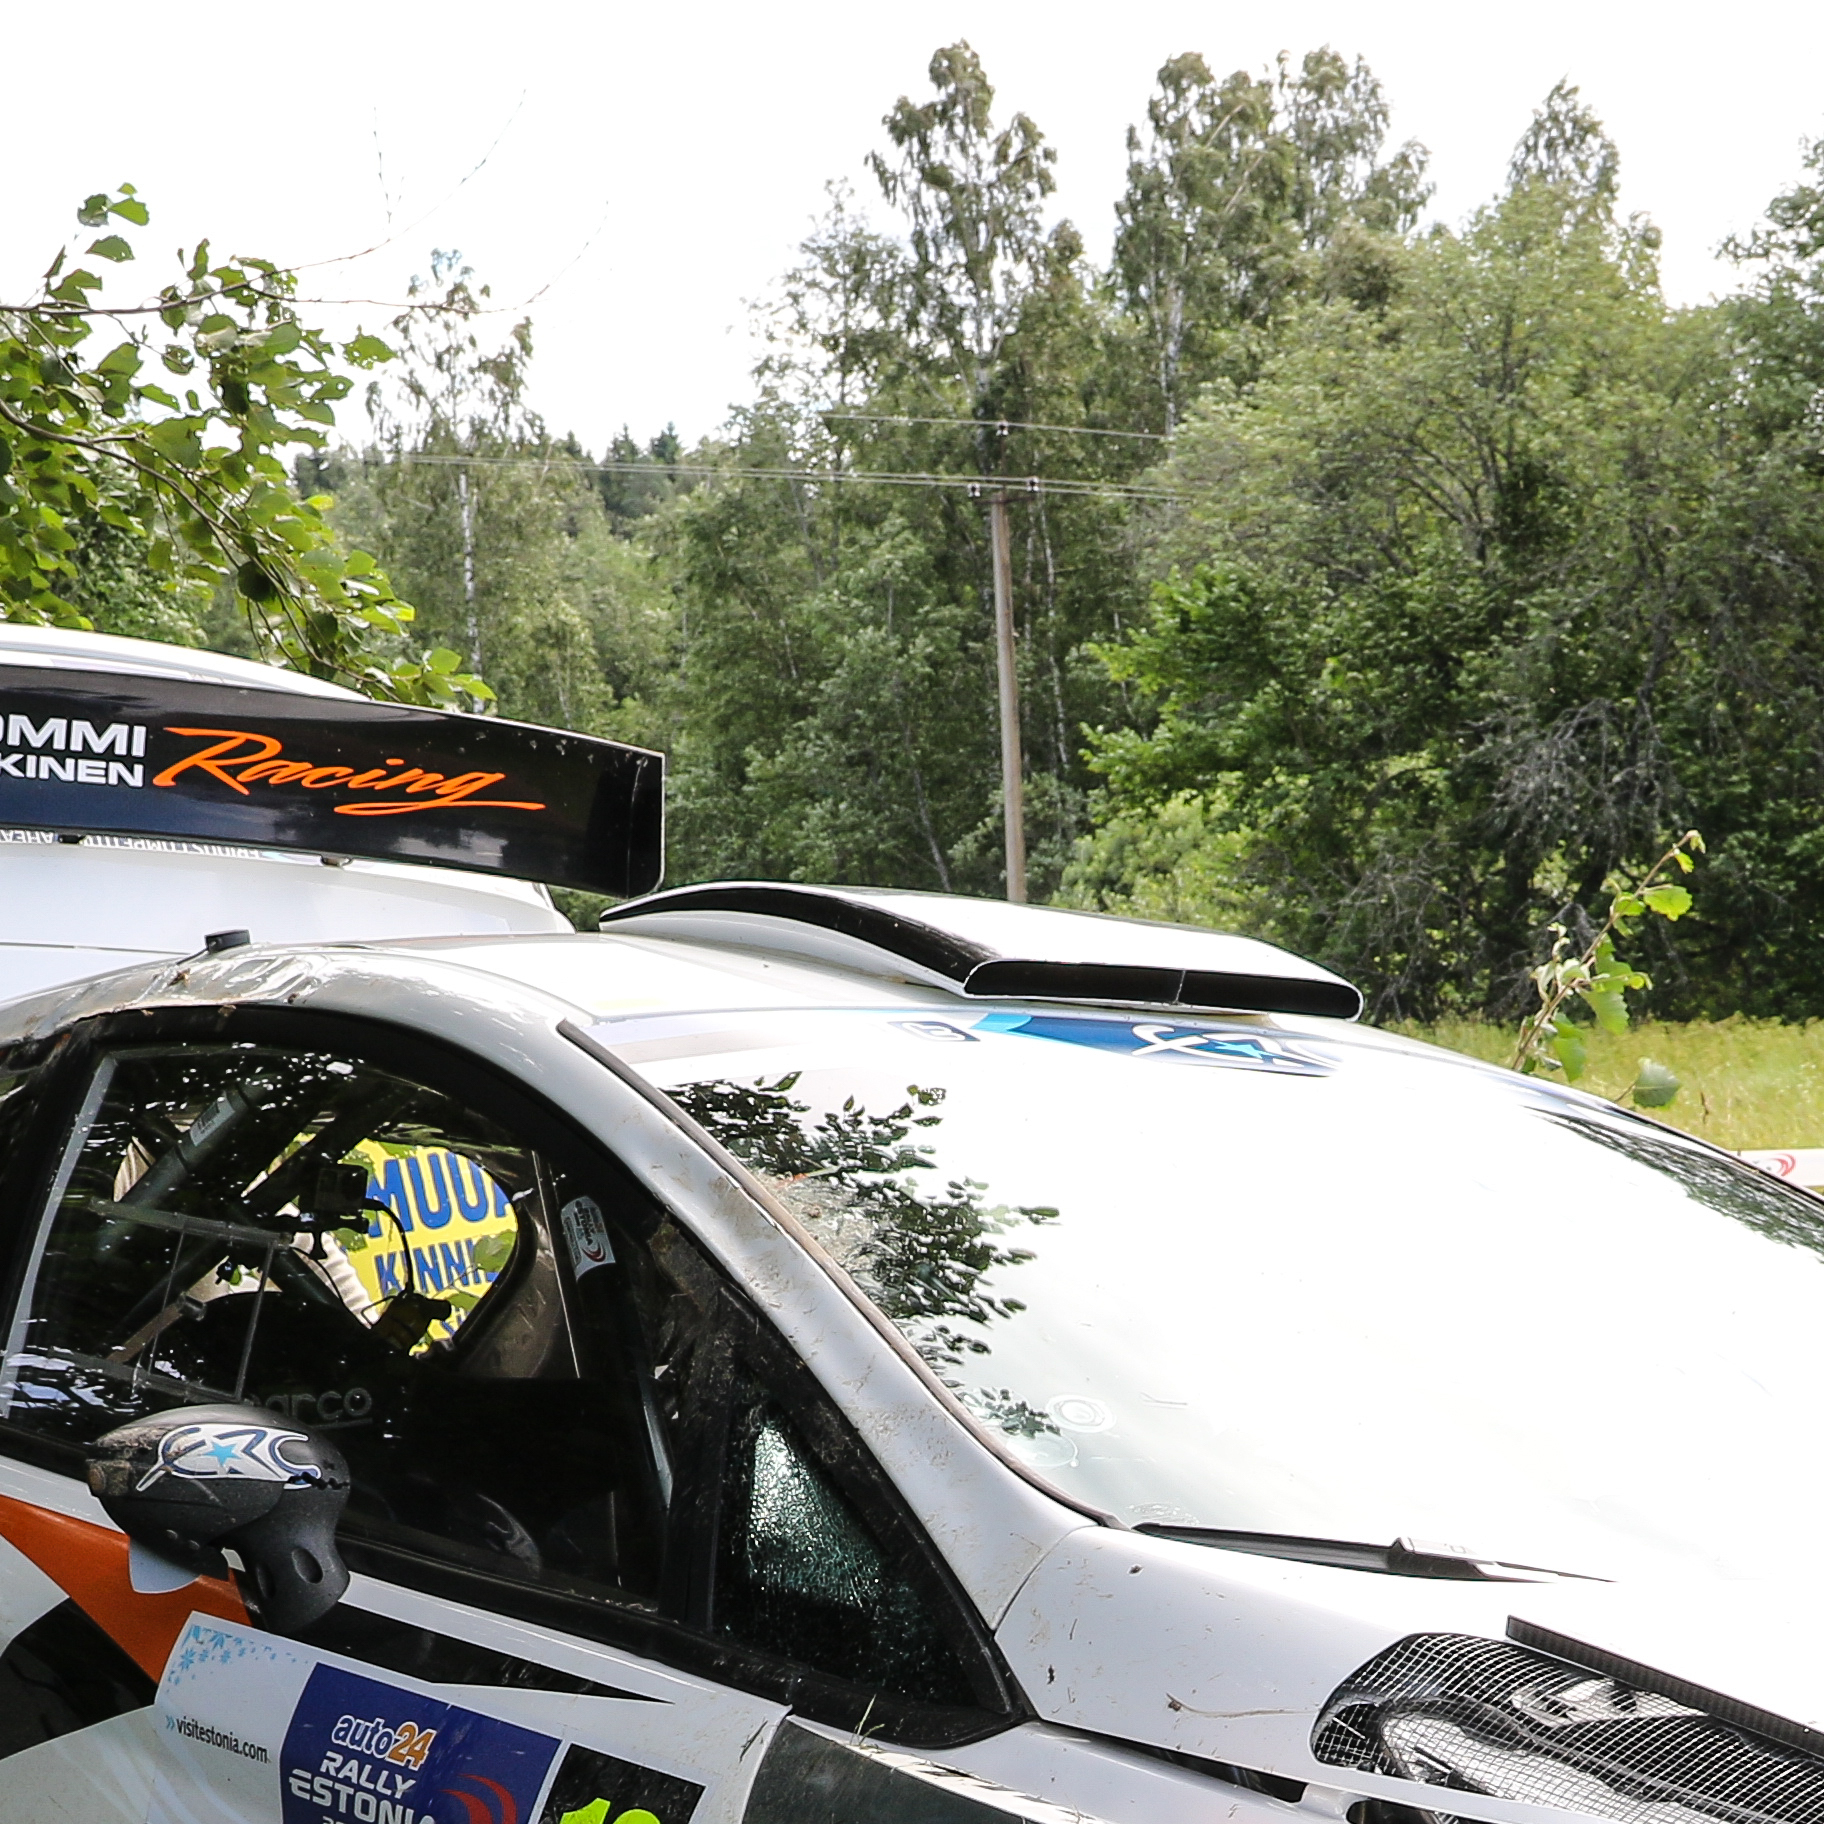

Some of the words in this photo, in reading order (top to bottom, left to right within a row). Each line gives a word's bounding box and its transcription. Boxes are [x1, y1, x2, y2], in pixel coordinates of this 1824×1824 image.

[149, 725, 546, 815] Racing
[176, 1717, 269, 1764] visitestonia.com
[332, 1714, 437, 1771] auto24
[320, 1750, 417, 1799] RALLY
